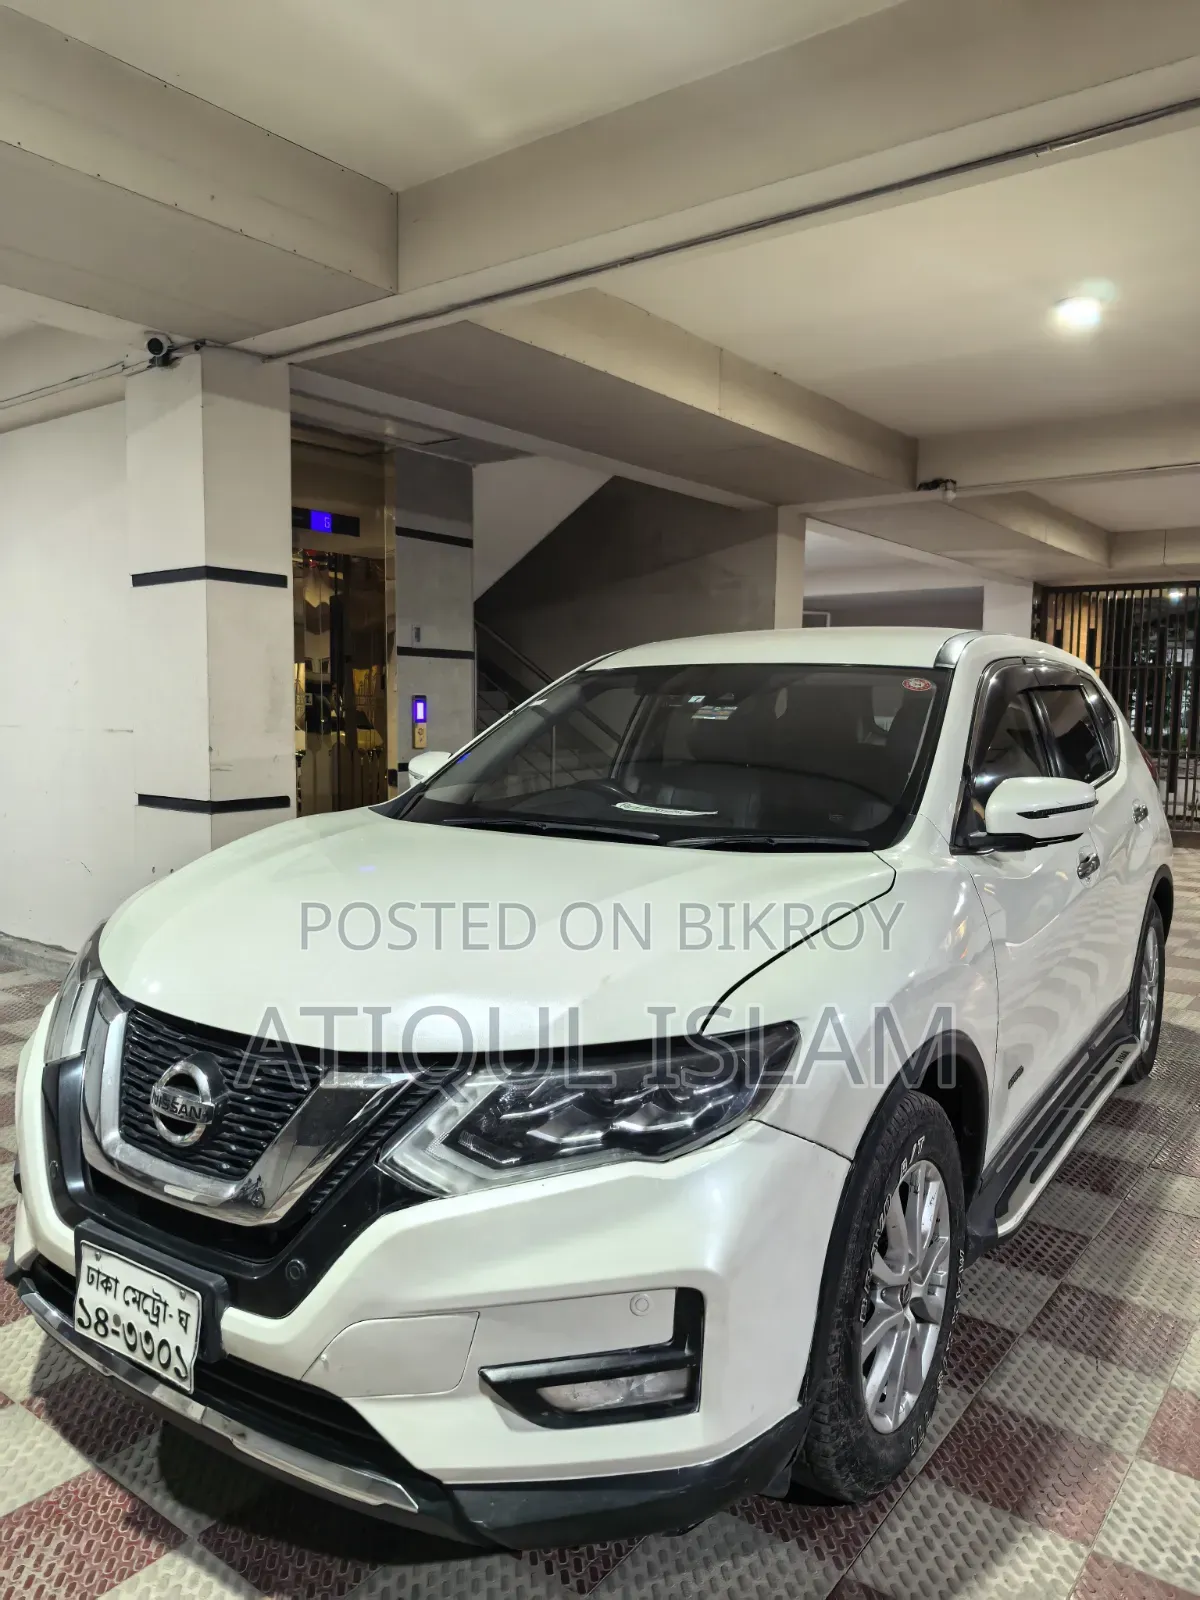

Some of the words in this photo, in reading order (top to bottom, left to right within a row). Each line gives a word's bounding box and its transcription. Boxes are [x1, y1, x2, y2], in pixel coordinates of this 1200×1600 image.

[152, 1090, 202, 1119] NISSAN
[86, 1265, 120, 1299] ঢাকা
[77, 1297, 188, 1382] ১৪-৩৩০১
